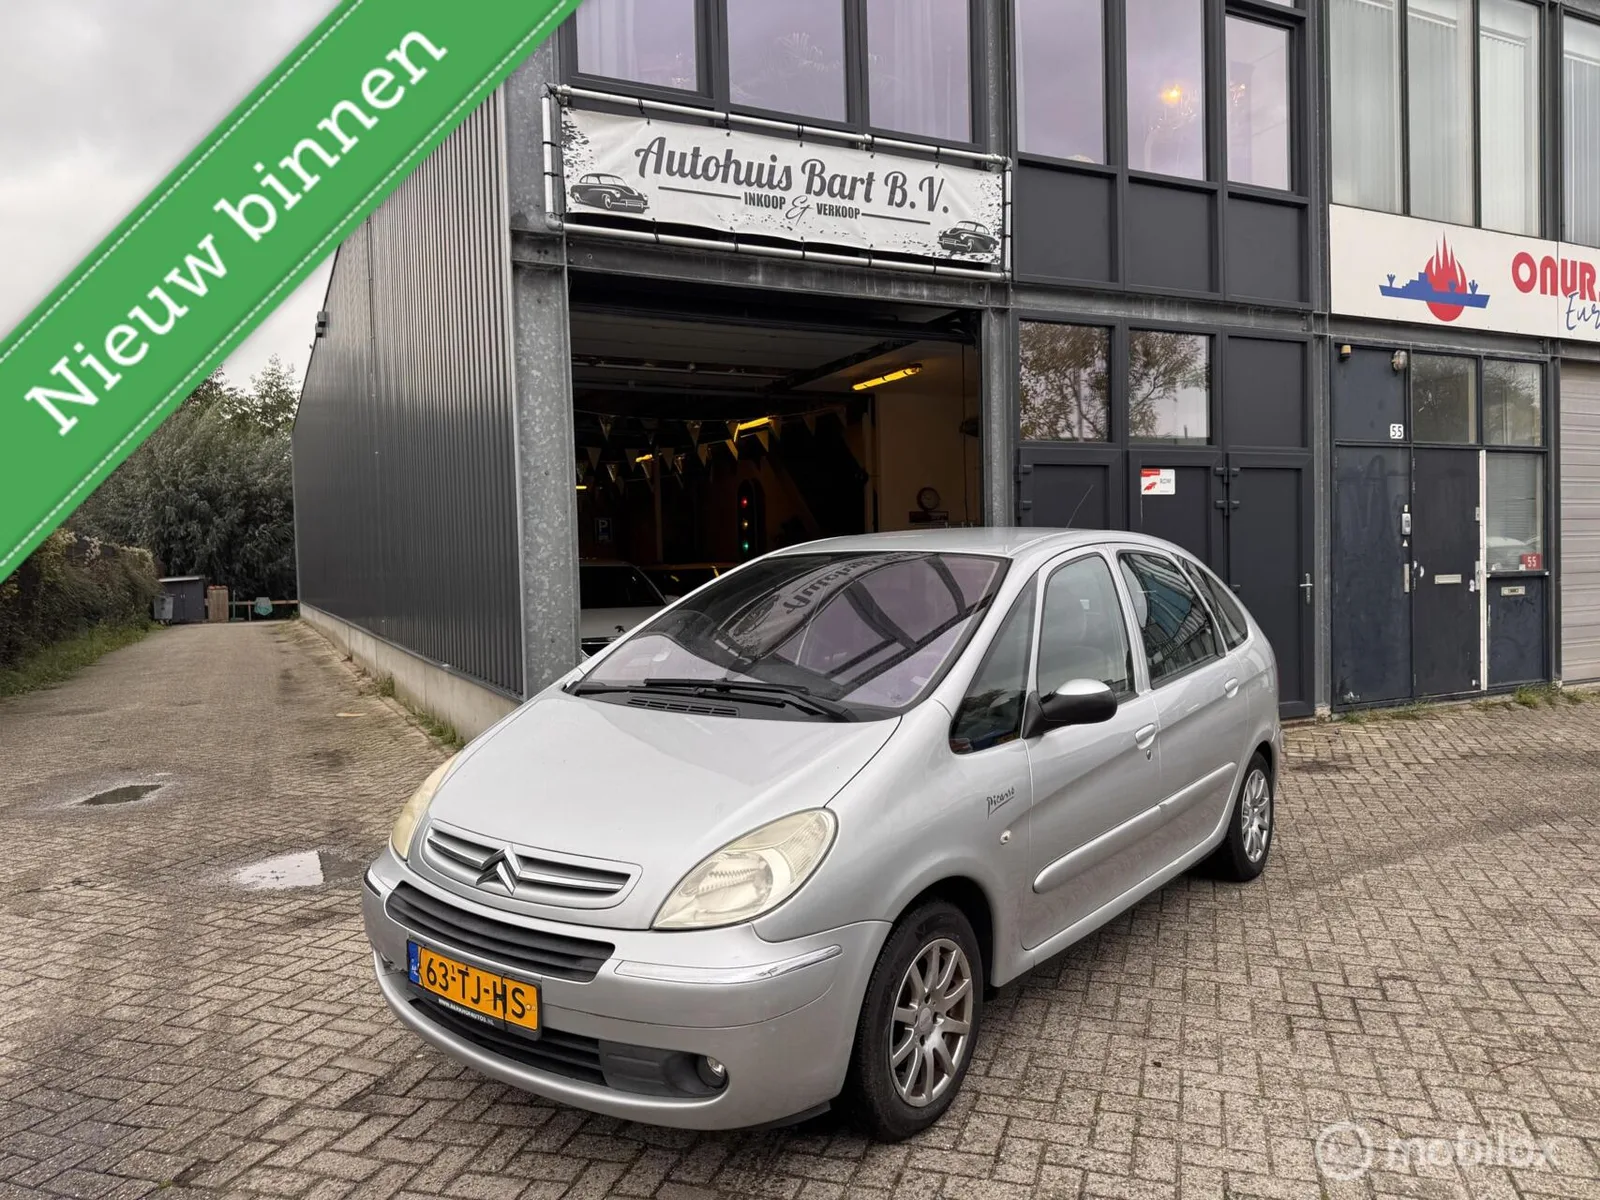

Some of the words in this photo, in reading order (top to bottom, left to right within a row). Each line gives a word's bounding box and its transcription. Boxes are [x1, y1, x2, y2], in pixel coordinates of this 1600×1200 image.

[634, 136, 793, 192] Autohuis
[800, 158, 876, 203] Bart
[883, 170, 950, 214] B.V.
[744, 191, 786, 211] INKOOP
[816, 203, 861, 220] VERKOOP
[1391, 425, 1403, 437] 55
[1527, 555, 1537, 568] 55
[426, 957, 526, 1019] 63-TJ-HS
